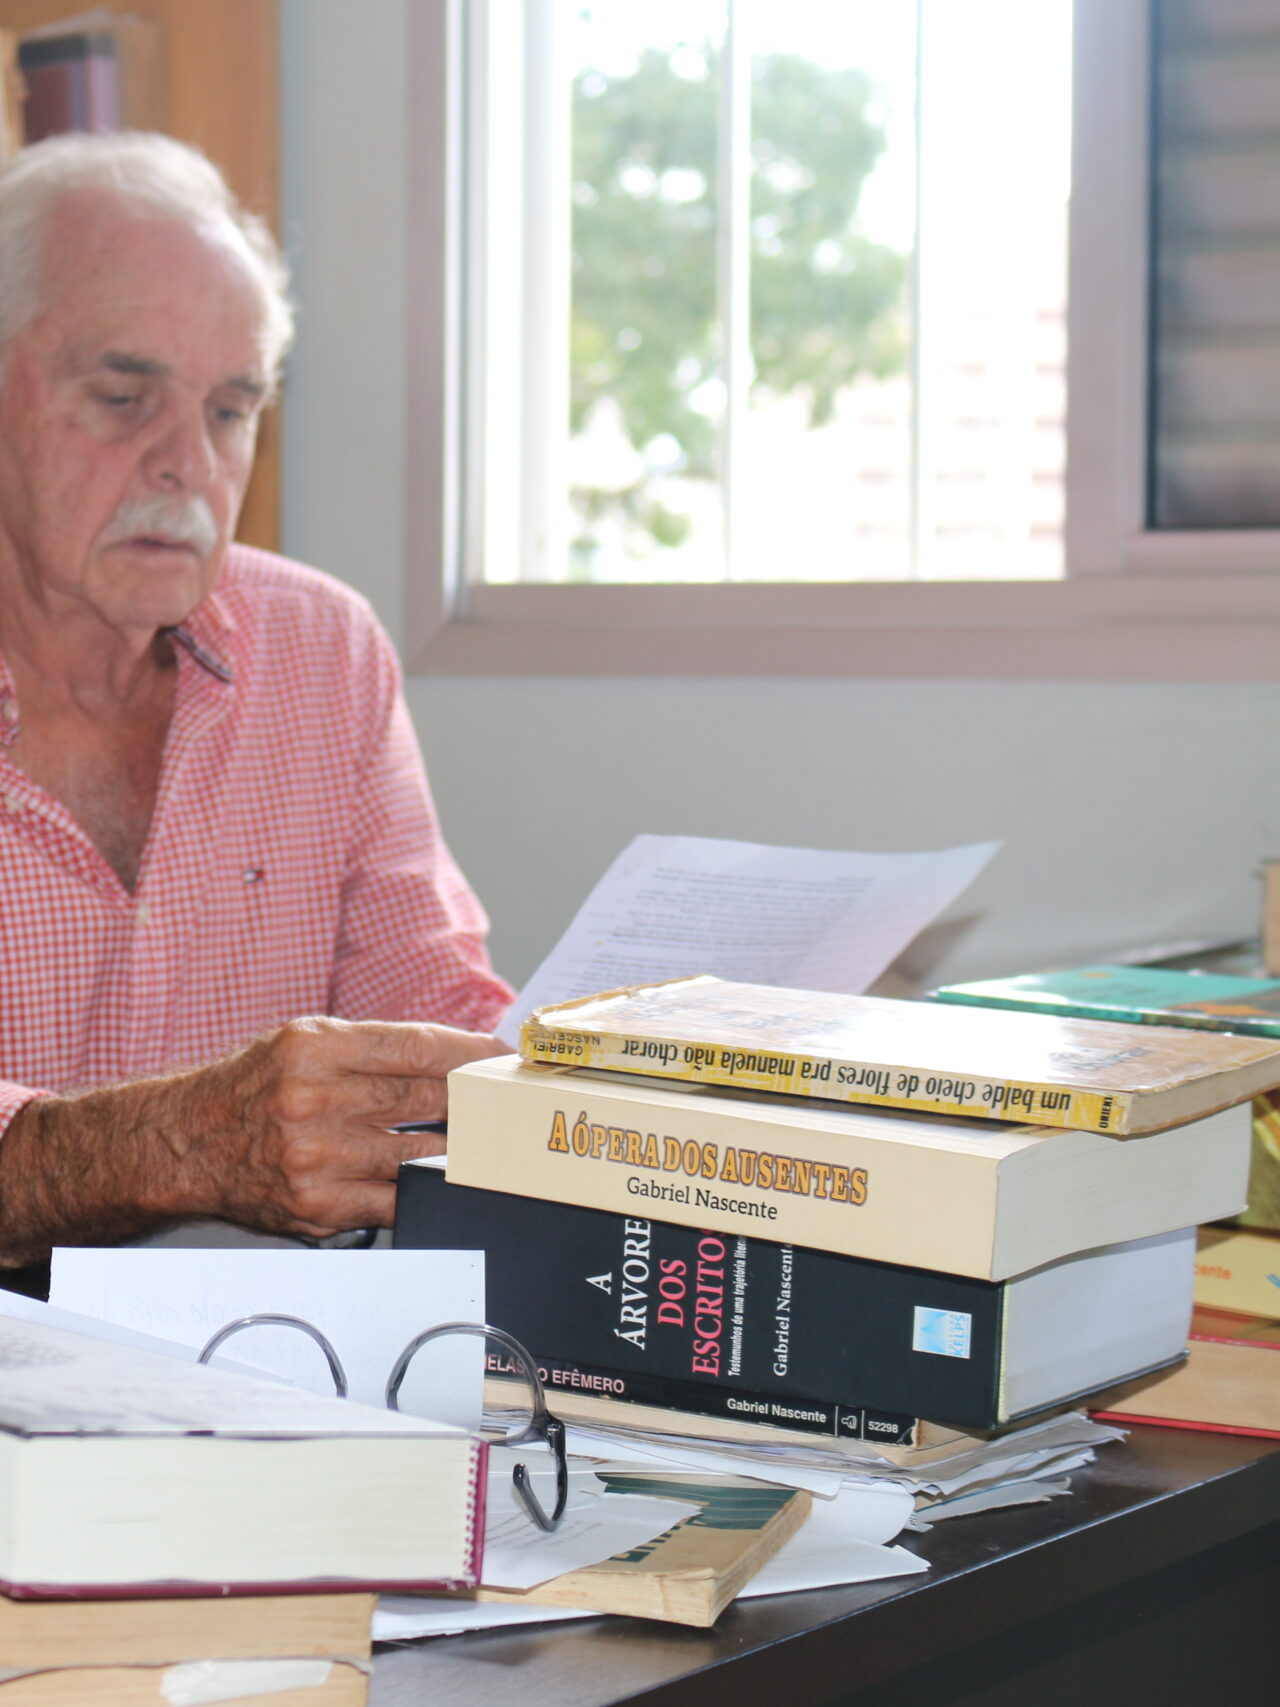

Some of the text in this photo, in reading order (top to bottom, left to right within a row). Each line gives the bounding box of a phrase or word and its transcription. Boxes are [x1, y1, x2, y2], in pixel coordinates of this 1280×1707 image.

[620, 1039, 1072, 1114] um balde cheio de flores pra manuela não chorar
[548, 1110, 869, 1207] A ÓPERA DOS AUSENTES
[626, 1176, 779, 1221] Gabriel Nascente
[585, 1271, 613, 1296] A
[612, 1218, 652, 1351] ÁRVORE
[656, 1258, 688, 1328] DOS
[732, 1260, 748, 1296] trajetória
[691, 1229, 726, 1378] ESCRITO
[730, 1315, 744, 1326] de
[733, 1296, 745, 1315] uma
[727, 1326, 744, 1377] Testemunhos
[772, 1316, 791, 1378] Gabriel
[953, 1314, 967, 1357] KELPS
[551, 1368, 626, 1394] EFÊMERO
[726, 1397, 899, 1435] Gabriel Nascente 52298
